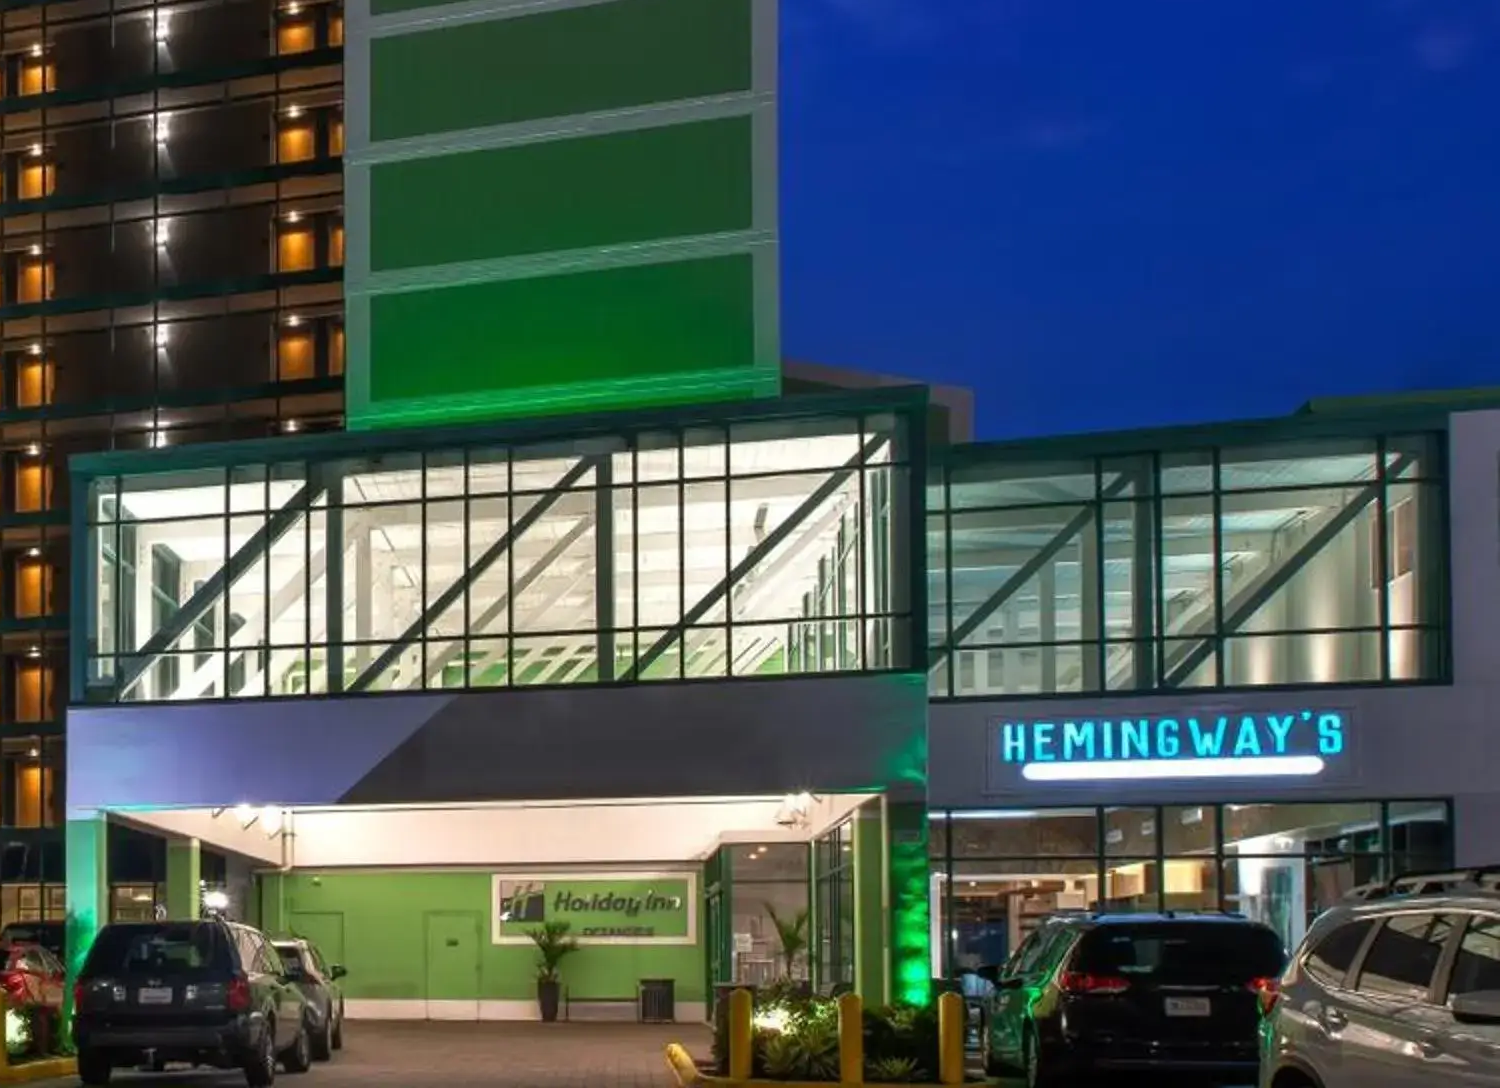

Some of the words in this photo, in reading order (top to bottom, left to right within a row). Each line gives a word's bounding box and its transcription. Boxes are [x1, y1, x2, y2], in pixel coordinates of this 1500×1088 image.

[1002, 711, 1344, 762] HEMINGWAY'S
[553, 889, 641, 918] Holiday
[645, 889, 683, 912] Inn
